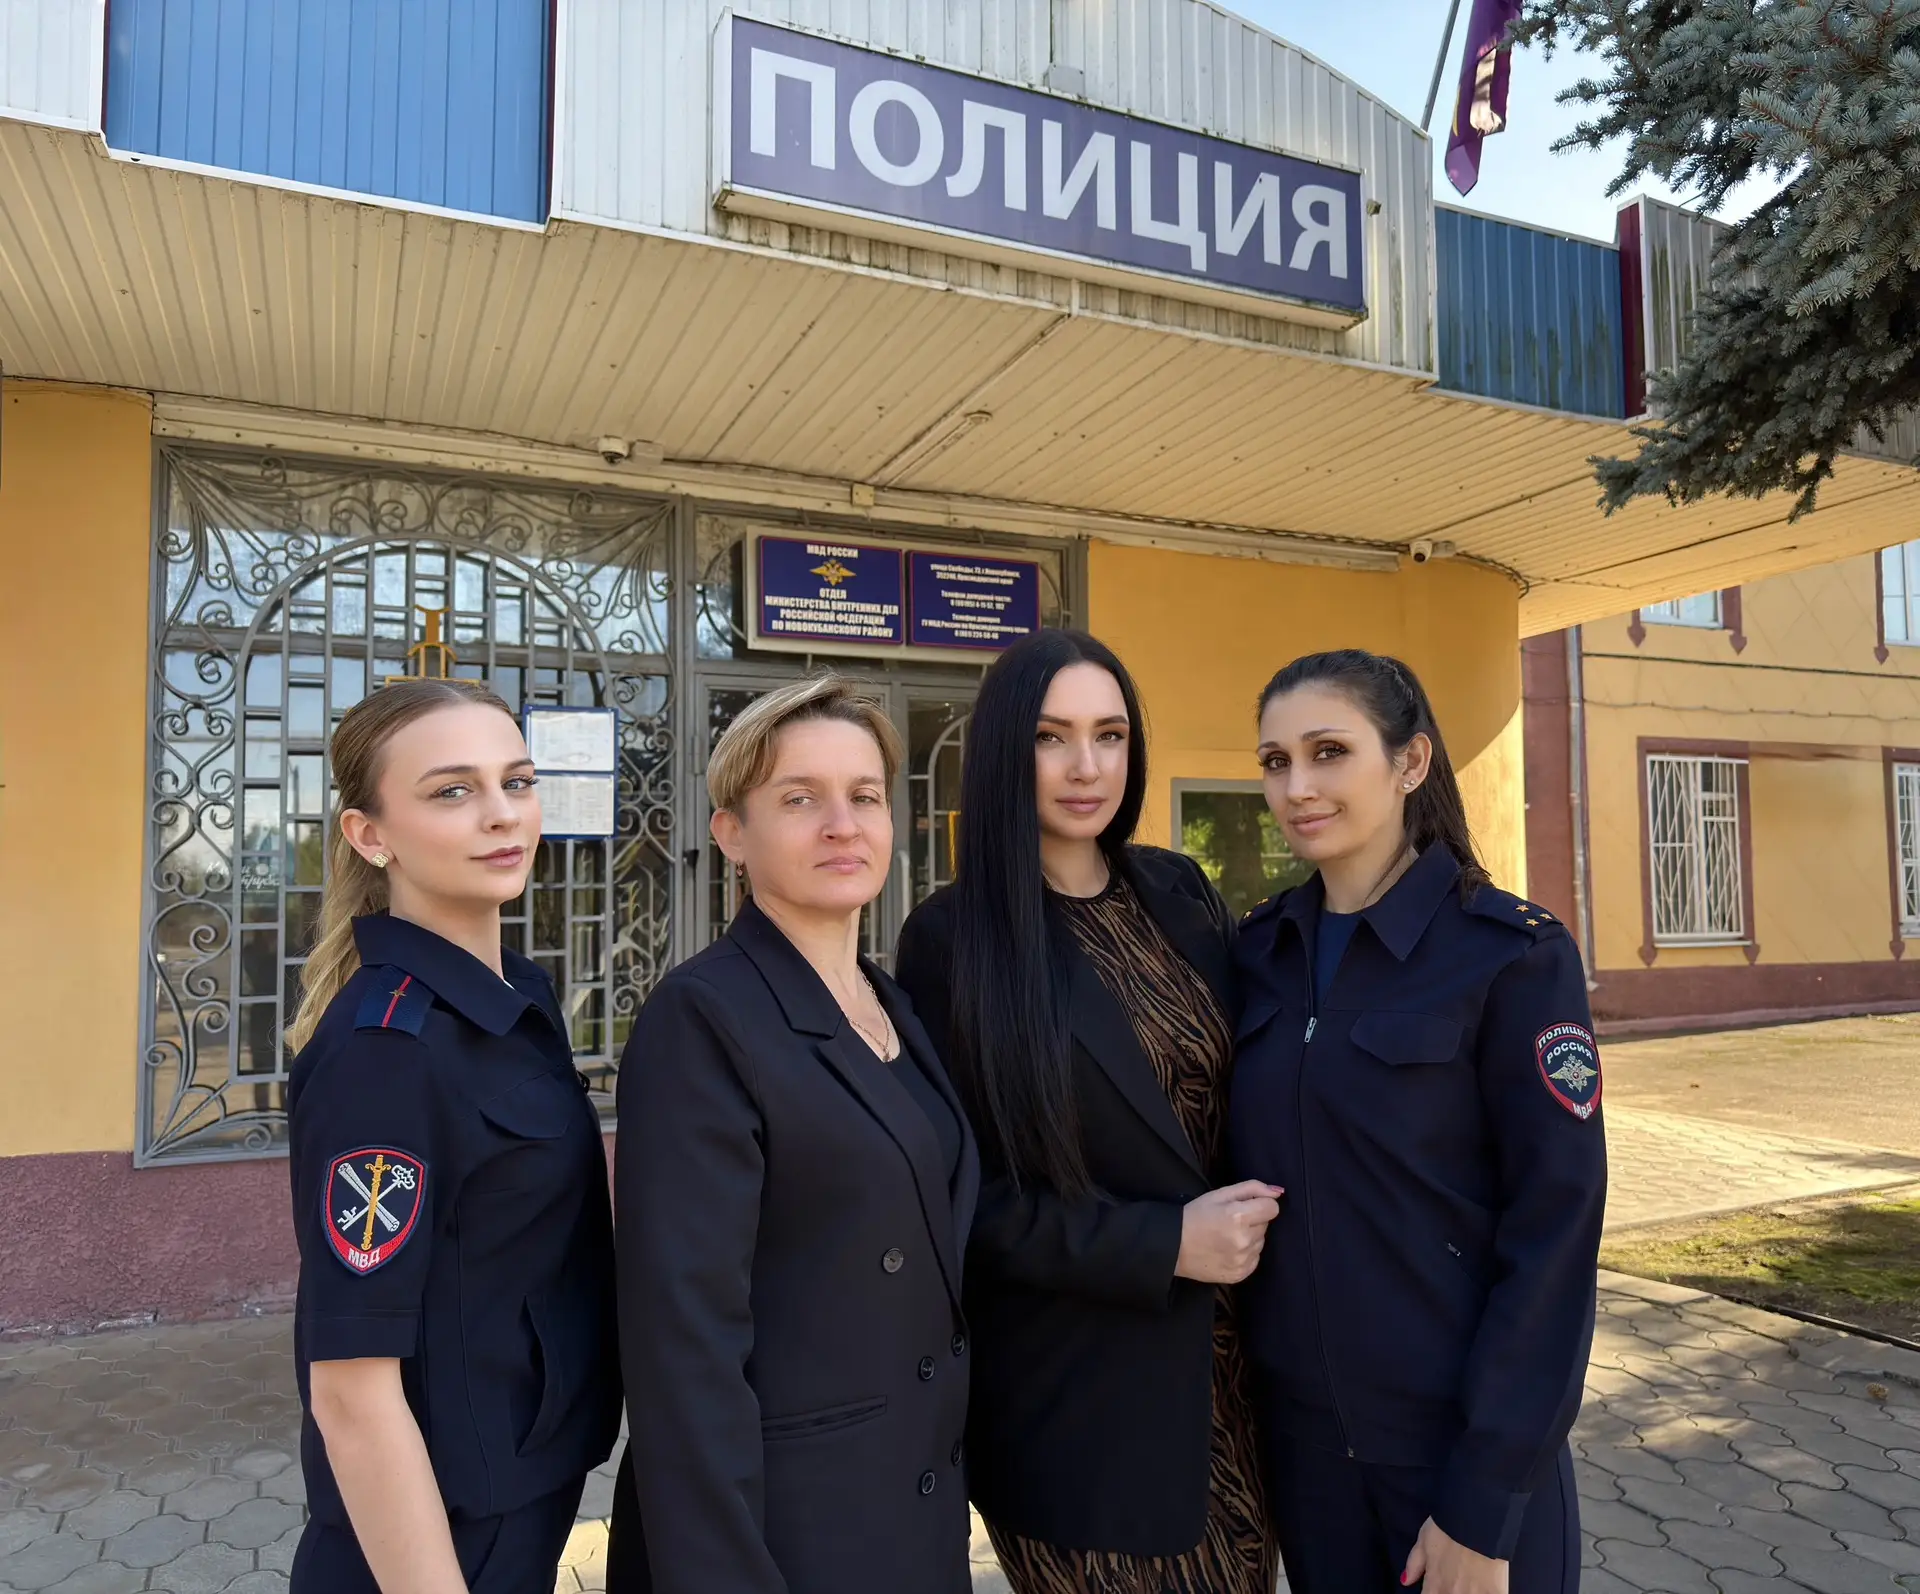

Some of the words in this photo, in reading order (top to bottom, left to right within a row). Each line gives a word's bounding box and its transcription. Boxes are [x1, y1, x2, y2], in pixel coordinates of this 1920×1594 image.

[750, 47, 1349, 280] ПОЛИЦИЯ
[807, 544, 826, 557] МВД
[827, 546, 859, 559] РОССИИ
[819, 587, 847, 600] ОТДЕЛ
[765, 595, 831, 610] МИНИСТЕРСТВА
[831, 600, 882, 615] ВНУТРЕННИХ
[882, 604, 899, 616] ДЕЛ
[780, 608, 836, 622] РОССИЙСКОЙ
[836, 612, 886, 626] ФЕДЕРАЦИИ
[772, 619, 784, 630] ПО
[785, 620, 862, 636] НОВОКУБАНСКОМУ
[862, 625, 894, 638] РАЙОНУ
[1538, 1025, 1592, 1049] ПОЛИЦИЯ
[1546, 1041, 1593, 1065] РОССИЯ
[1572, 1102, 1593, 1120] МВД
[348, 1247, 380, 1268] МВД
